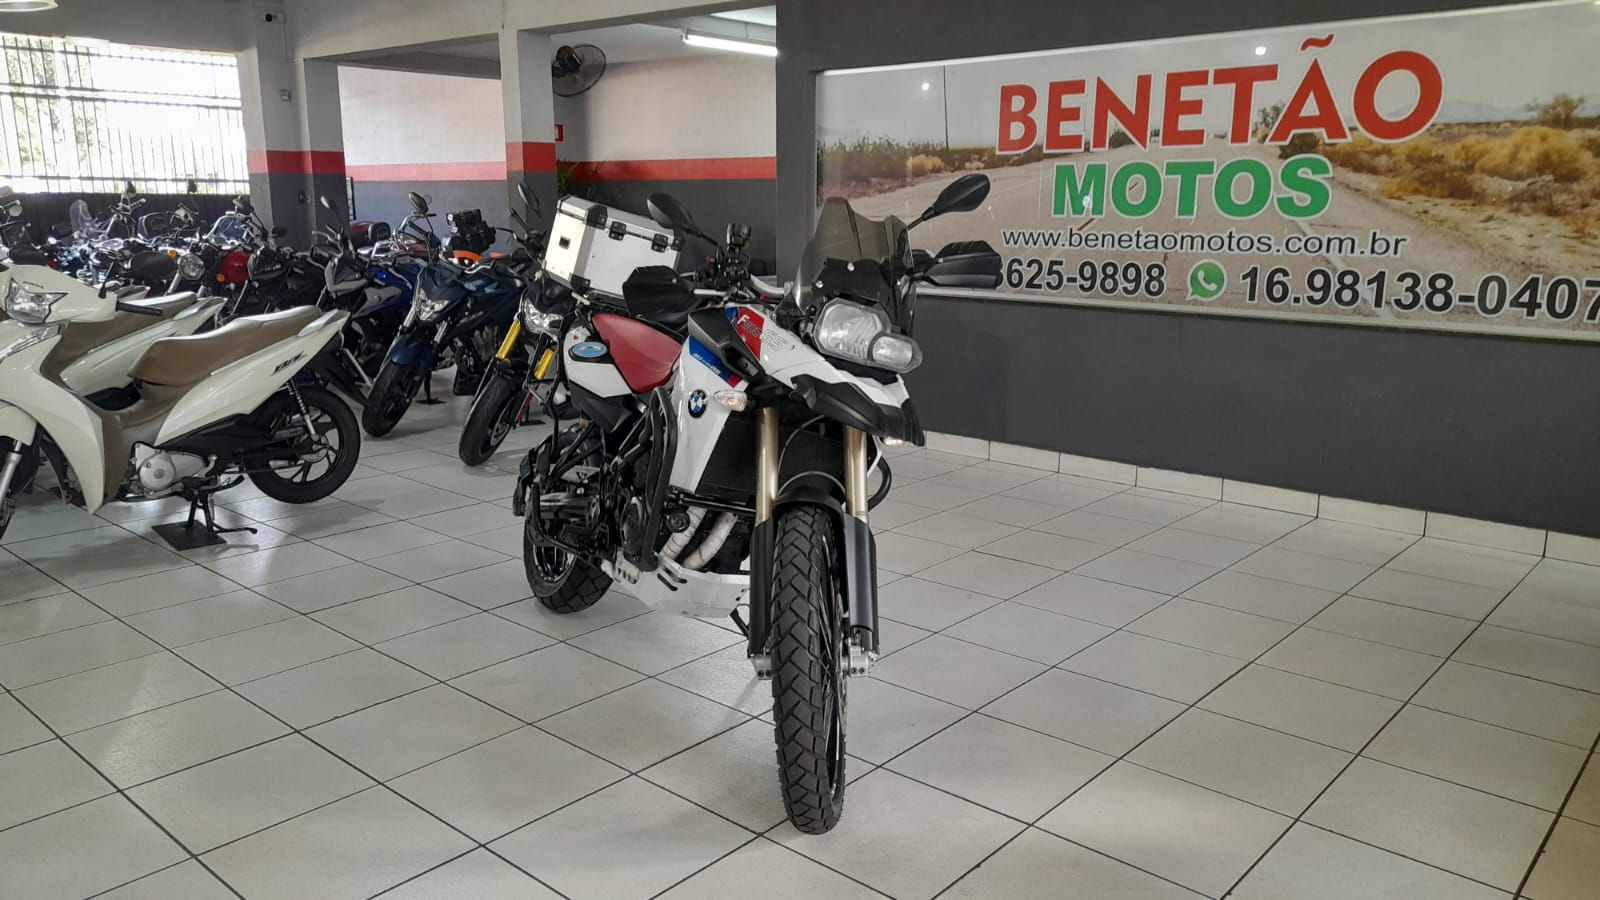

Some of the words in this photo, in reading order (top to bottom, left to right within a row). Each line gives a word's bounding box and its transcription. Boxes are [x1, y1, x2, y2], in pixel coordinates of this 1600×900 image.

[998, 34, 1443, 152] BENETÃO
[1053, 156, 1332, 217] MOTOS
[1003, 227, 1407, 257] www.benetaomotos.com.br
[1240, 266, 1600, 321] 16.98138-0407
